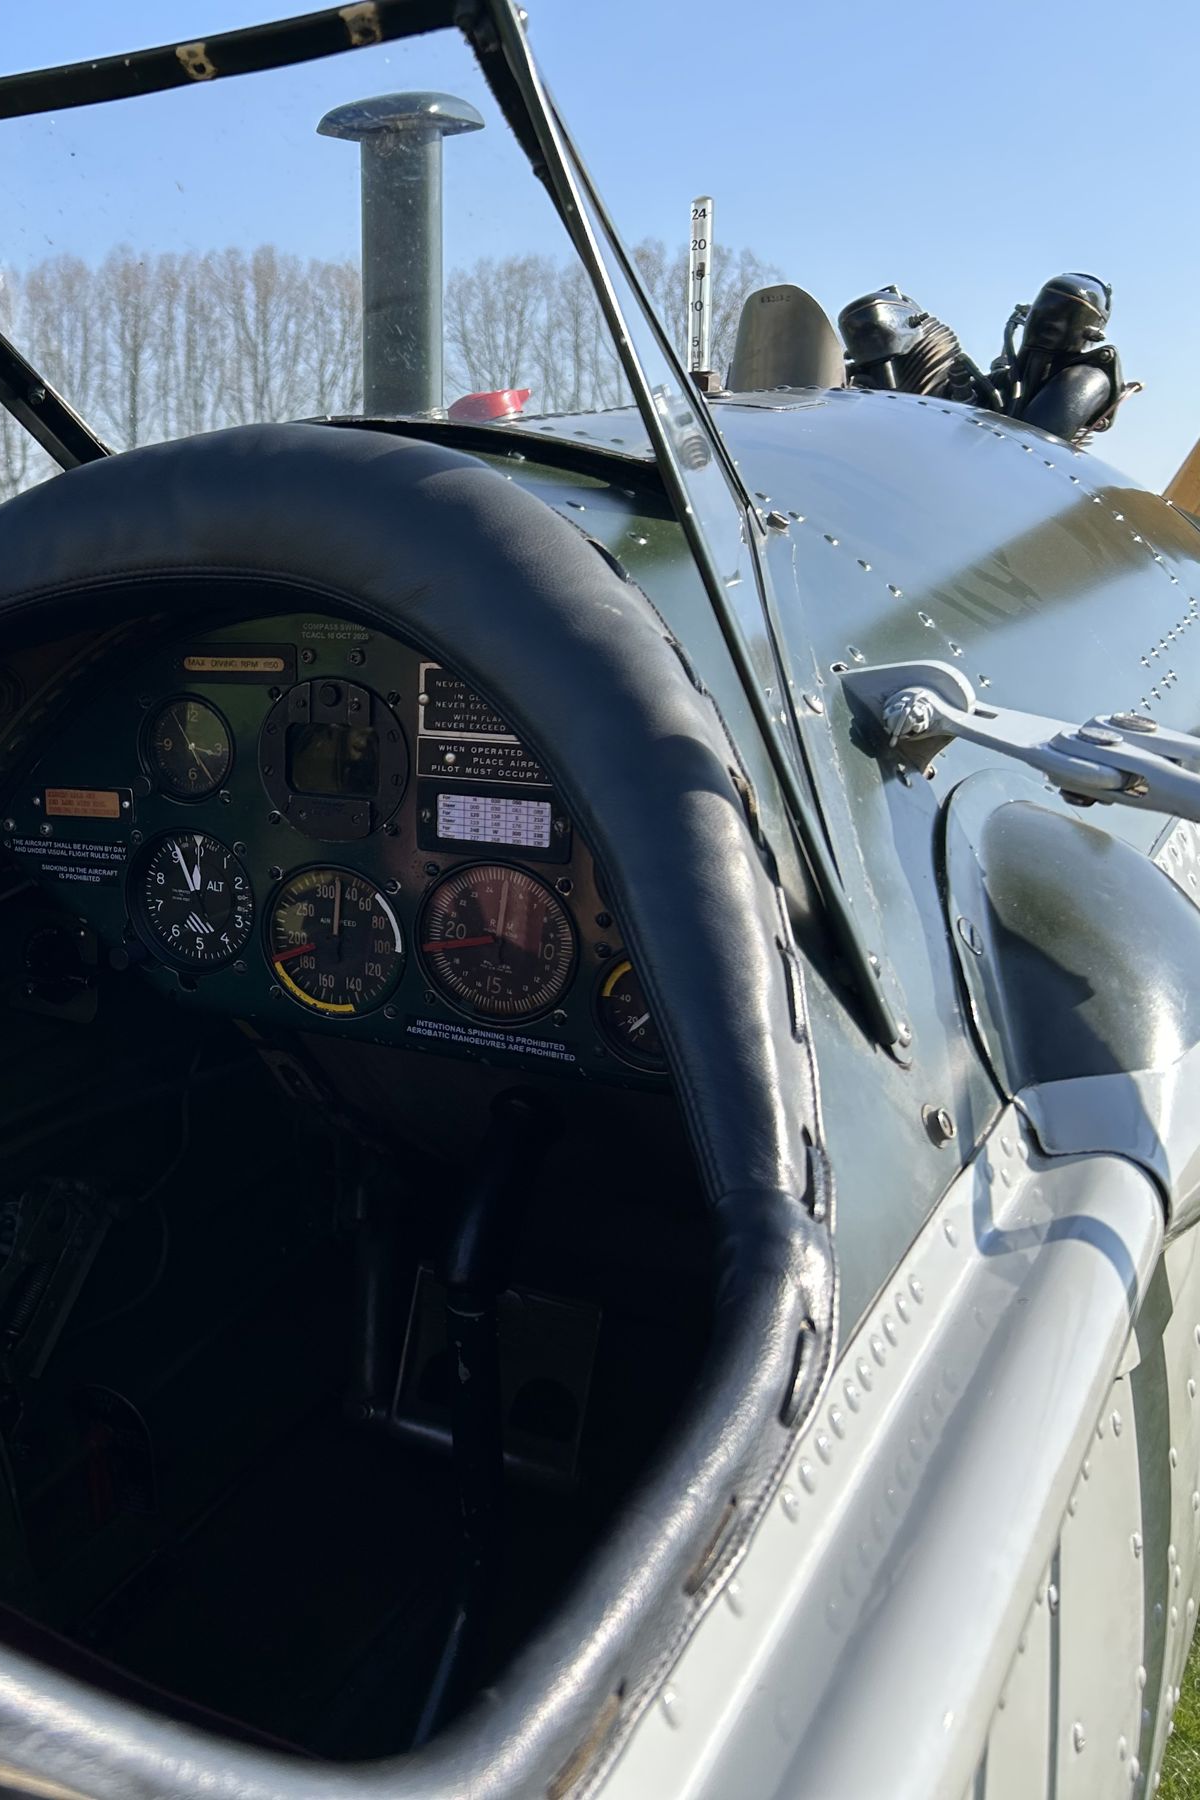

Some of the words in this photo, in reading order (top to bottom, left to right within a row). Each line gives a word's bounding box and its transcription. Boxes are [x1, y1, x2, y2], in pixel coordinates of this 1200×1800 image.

[691, 208, 707, 220] 24
[691, 239, 707, 250] 20
[690, 302, 704, 312] 10
[692, 336, 700, 348] 5
[302, 623, 338, 631] COMPASS
[336, 632, 351, 640] OCT
[188, 659, 205, 667] MAX
[211, 660, 237, 668] DIVING
[240, 660, 258, 668] RPM
[435, 701, 466, 709] NEVER
[453, 714, 477, 722] WITH
[434, 720, 465, 730] NEVER
[470, 723, 506, 732] EXCEED
[163, 738, 172, 751] 9
[438, 744, 465, 753] WHEN
[470, 746, 524, 757] OPERATED
[472, 757, 504, 766] PLACE
[510, 760, 540, 769] AIRPL
[188, 768, 198, 780] 6
[432, 764, 460, 774] PILOT
[465, 767, 492, 776] MUST
[498, 769, 540, 780] OCCUPY
[24, 840, 52, 848] AIRCRAFT
[113, 846, 126, 854] DAY
[47, 848, 68, 856] VISUAL
[69, 850, 90, 858] FLIGHT
[110, 853, 126, 861] ONLY
[172, 850, 180, 863] 9
[41, 864, 68, 872] SMOKING
[88, 868, 118, 877] AIRCRAFT
[66, 874, 100, 882] PROHIBITED
[156, 872, 165, 884] 8
[234, 876, 244, 890] 2
[206, 880, 224, 892] ALT
[316, 884, 334, 899] 300
[345, 888, 358, 900] 40
[156, 898, 164, 911] 7
[296, 902, 314, 917] 250
[358, 898, 372, 911] 60
[234, 915, 244, 928] 3
[372, 916, 384, 929] 80
[172, 924, 180, 936] 6
[445, 920, 466, 940] 20
[196, 937, 204, 950] 5
[220, 932, 230, 944] 4
[288, 930, 307, 944] 200
[374, 940, 390, 954] 100
[538, 941, 555, 960] 10
[300, 956, 316, 970] 180
[365, 962, 381, 977] 120
[319, 973, 335, 988] 160
[345, 977, 362, 992] 140
[486, 975, 502, 994] 15
[534, 976, 541, 984] 12
[620, 994, 632, 1002] 40
[416, 1018, 466, 1034] INTENTIONAL
[468, 1028, 504, 1042] SPINNING
[506, 1034, 514, 1043] IS
[515, 1036, 565, 1051] PROHIBITED
[639, 1028, 645, 1036] 0
[407, 1025, 450, 1040] AEROBATIC
[451, 1033, 506, 1050] MANOEUVRES
[508, 1042, 524, 1052] ARE
[526, 1046, 576, 1062] PROHIBITED
